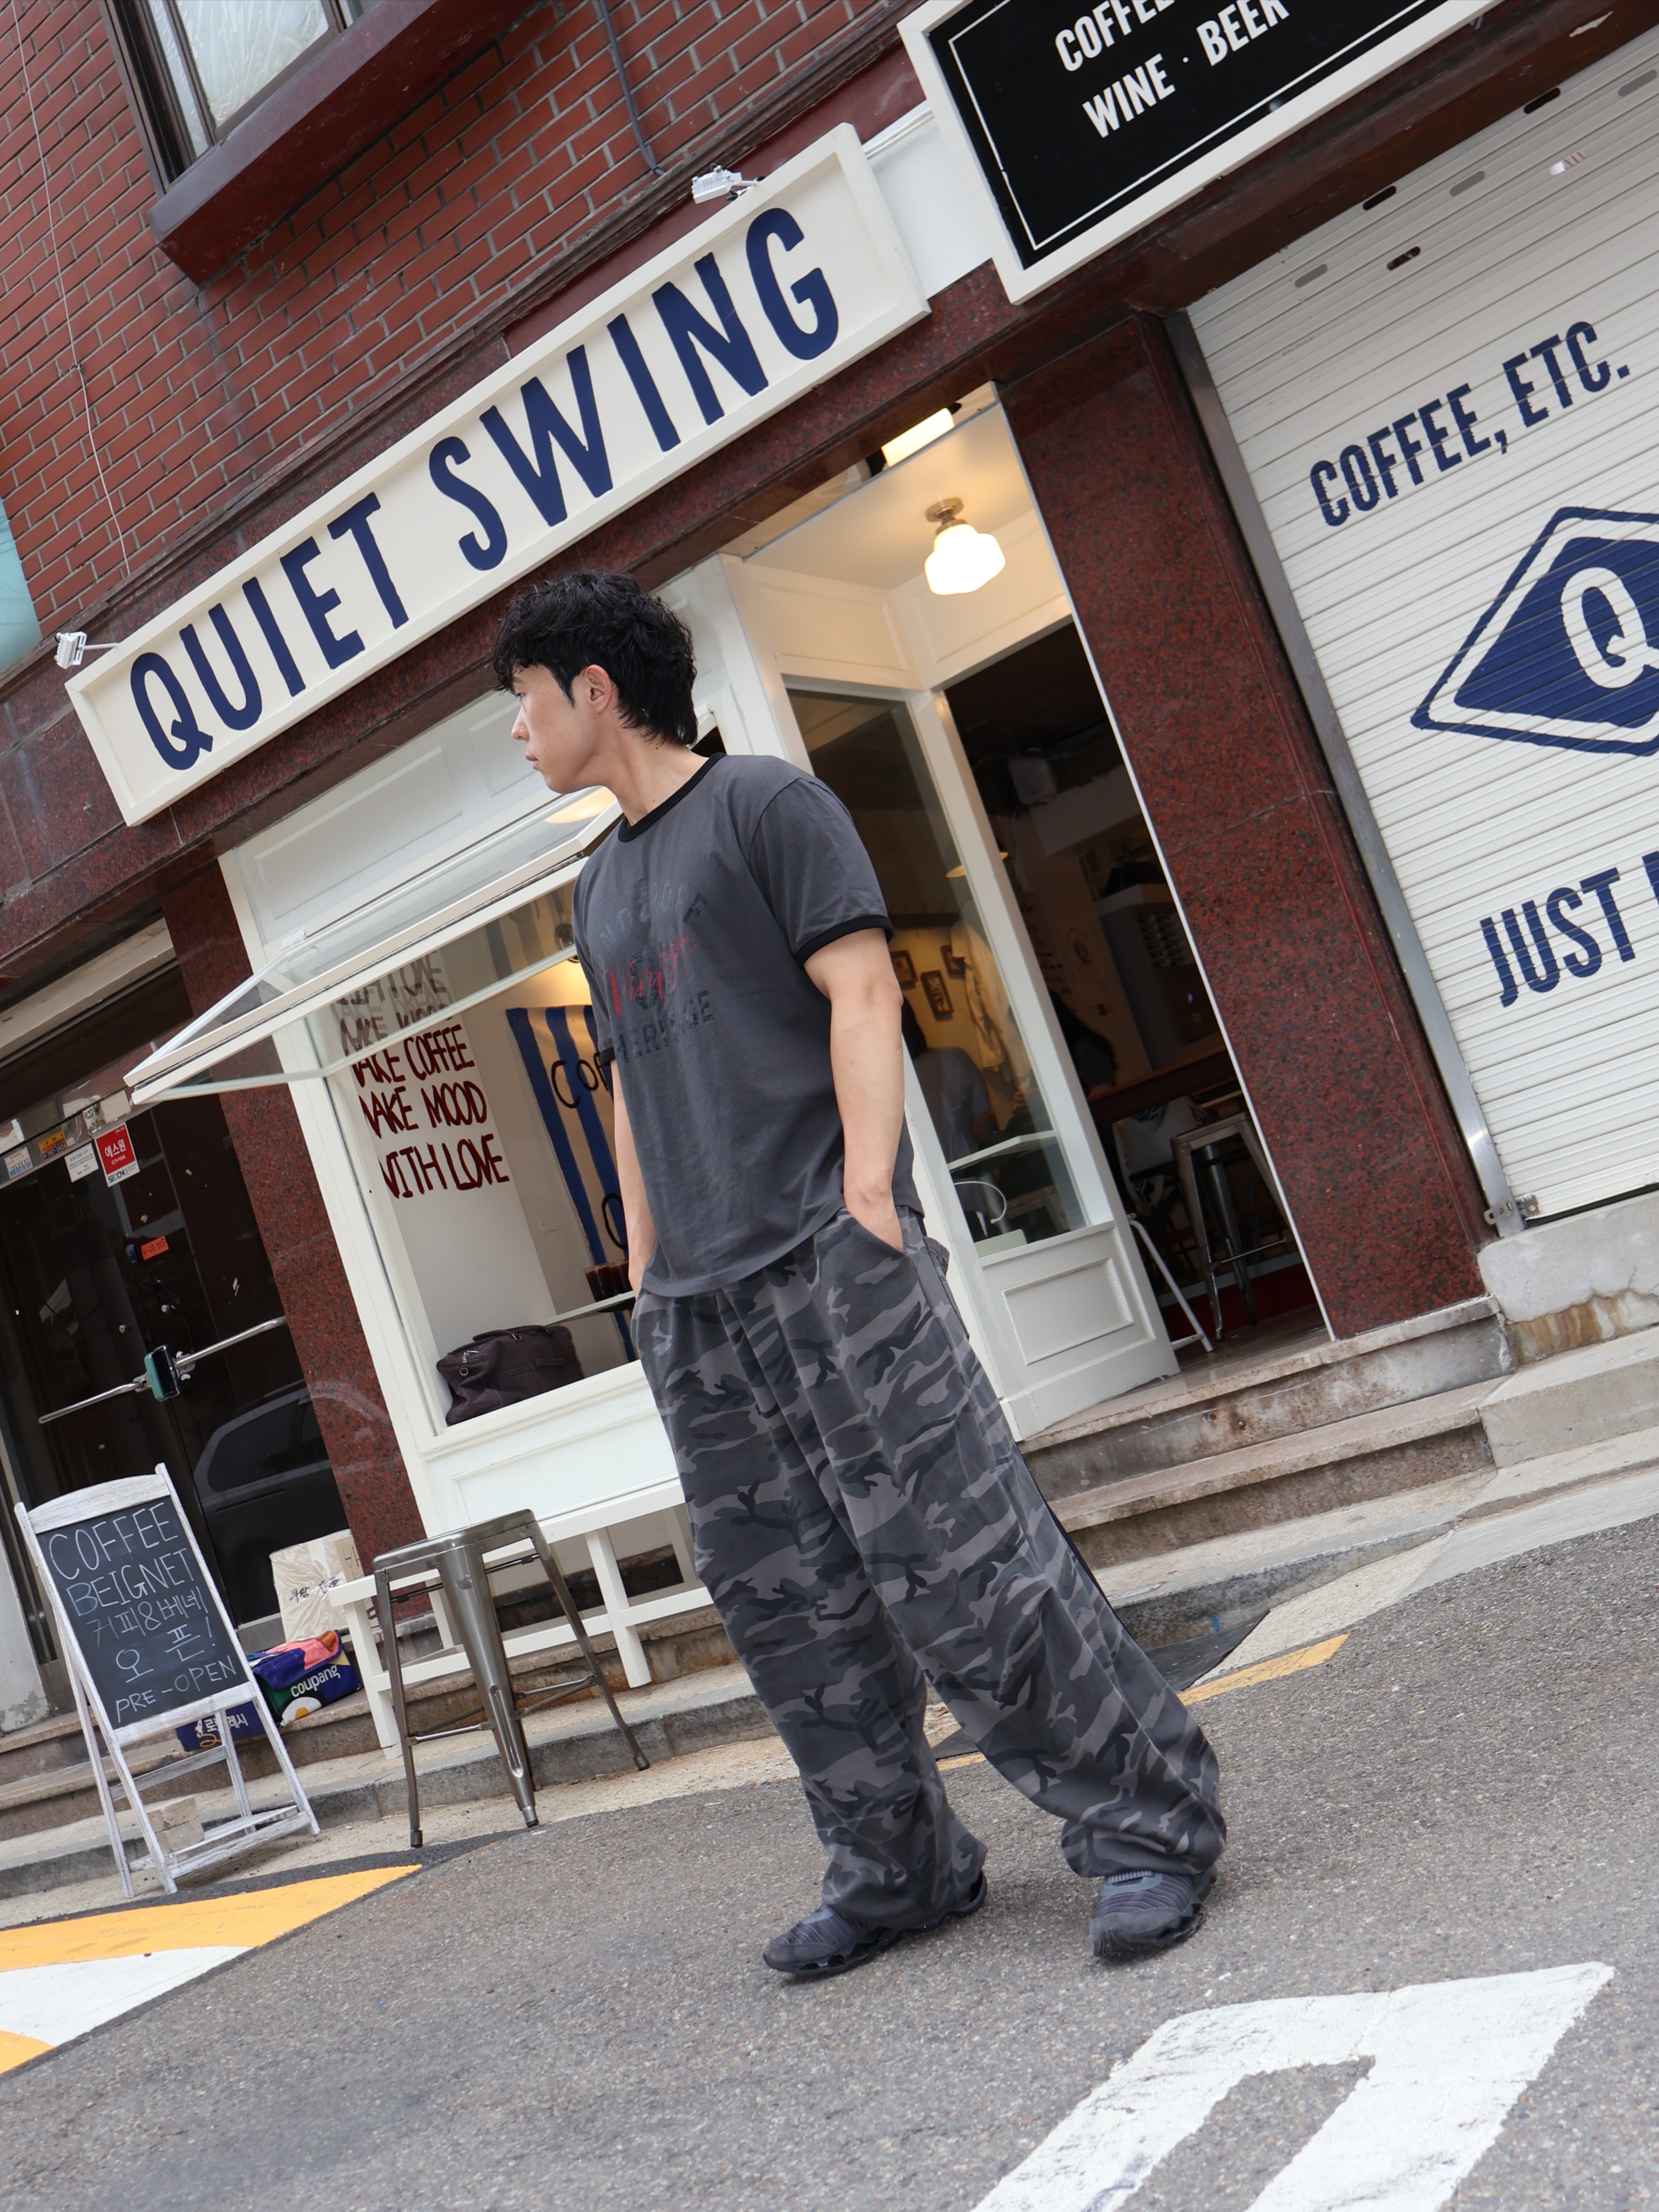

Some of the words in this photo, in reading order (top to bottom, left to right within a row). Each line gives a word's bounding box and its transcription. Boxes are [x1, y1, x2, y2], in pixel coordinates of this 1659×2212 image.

[1055, 0, 1175, 71] COFFE
[1082, 53, 1176, 138] WINE
[1310, 383, 1508, 526] COFFEE,
[1502, 321, 1630, 428] ETC.
[130, 491, 409, 770] QUIET
[428, 207, 839, 571] SWING
[1560, 567, 1659, 689] Q
[1480, 867, 1636, 1008] JUST
[403, 1023, 475, 1081] COFFEE
[617, 989, 715, 1063] HERIGE
[420, 1080, 488, 1129] MOOD
[104, 1138, 126, 1158] 에스원
[108, 1169, 126, 1183] SECOM
[442, 1133, 510, 1191] LOVE
[49, 1502, 178, 1580] COFFEE
[66, 1548, 194, 1616] BEIGNET
[291, 1664, 341, 1697] coupang
[204, 1712, 248, 1733] 로레시
